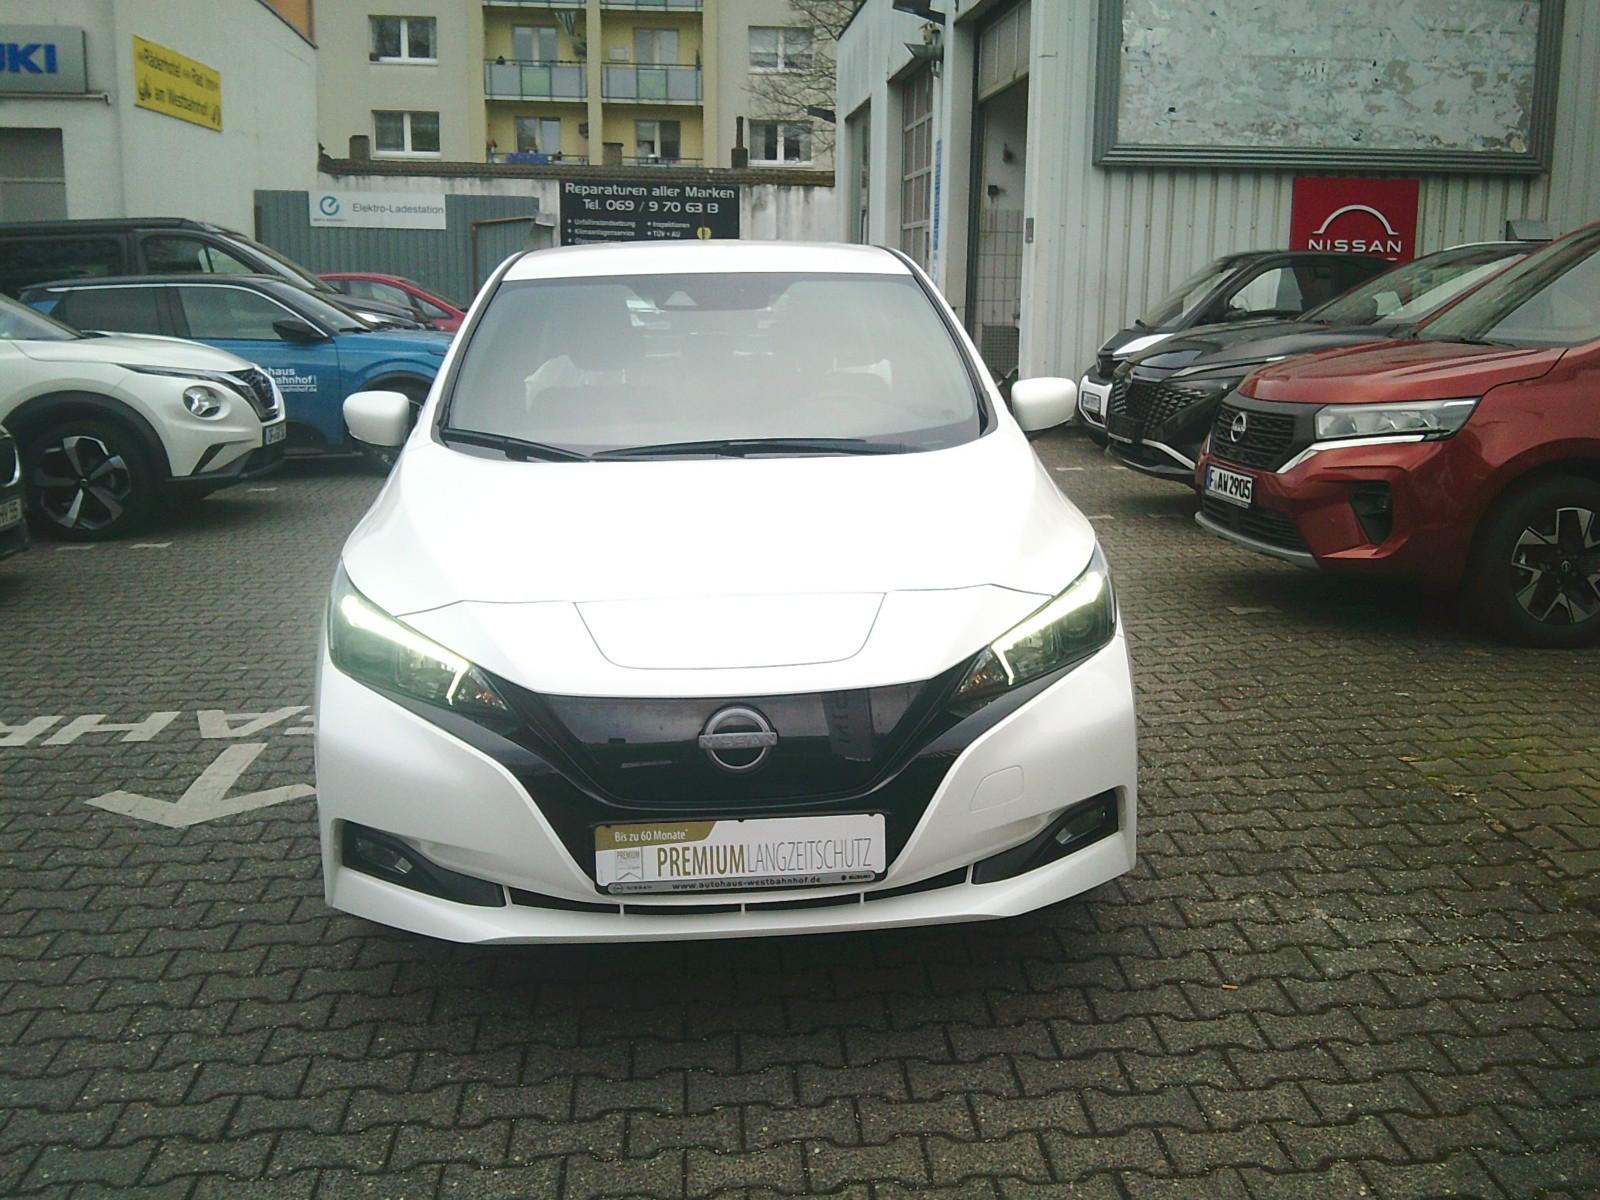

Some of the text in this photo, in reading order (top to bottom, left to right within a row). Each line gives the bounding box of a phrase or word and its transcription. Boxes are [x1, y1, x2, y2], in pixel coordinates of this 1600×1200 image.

[0, 43, 57, 73] KI
[565, 183, 735, 199] Reparaturen aller Marken
[352, 203, 444, 214] Elektro-Ladestation
[582, 199, 600, 210] Tel.
[606, 200, 634, 211] 069
[639, 201, 645, 212] /
[649, 201, 658, 212] 9
[663, 202, 681, 213] 70
[685, 203, 703, 214] 63
[1308, 239, 1402, 253] NISSAN
[614, 831, 627, 842] Bis
[629, 832, 639, 841] zu
[640, 831, 652, 841] 60
[672, 874, 821, 890] www.autohaus-westbahnhof.de
